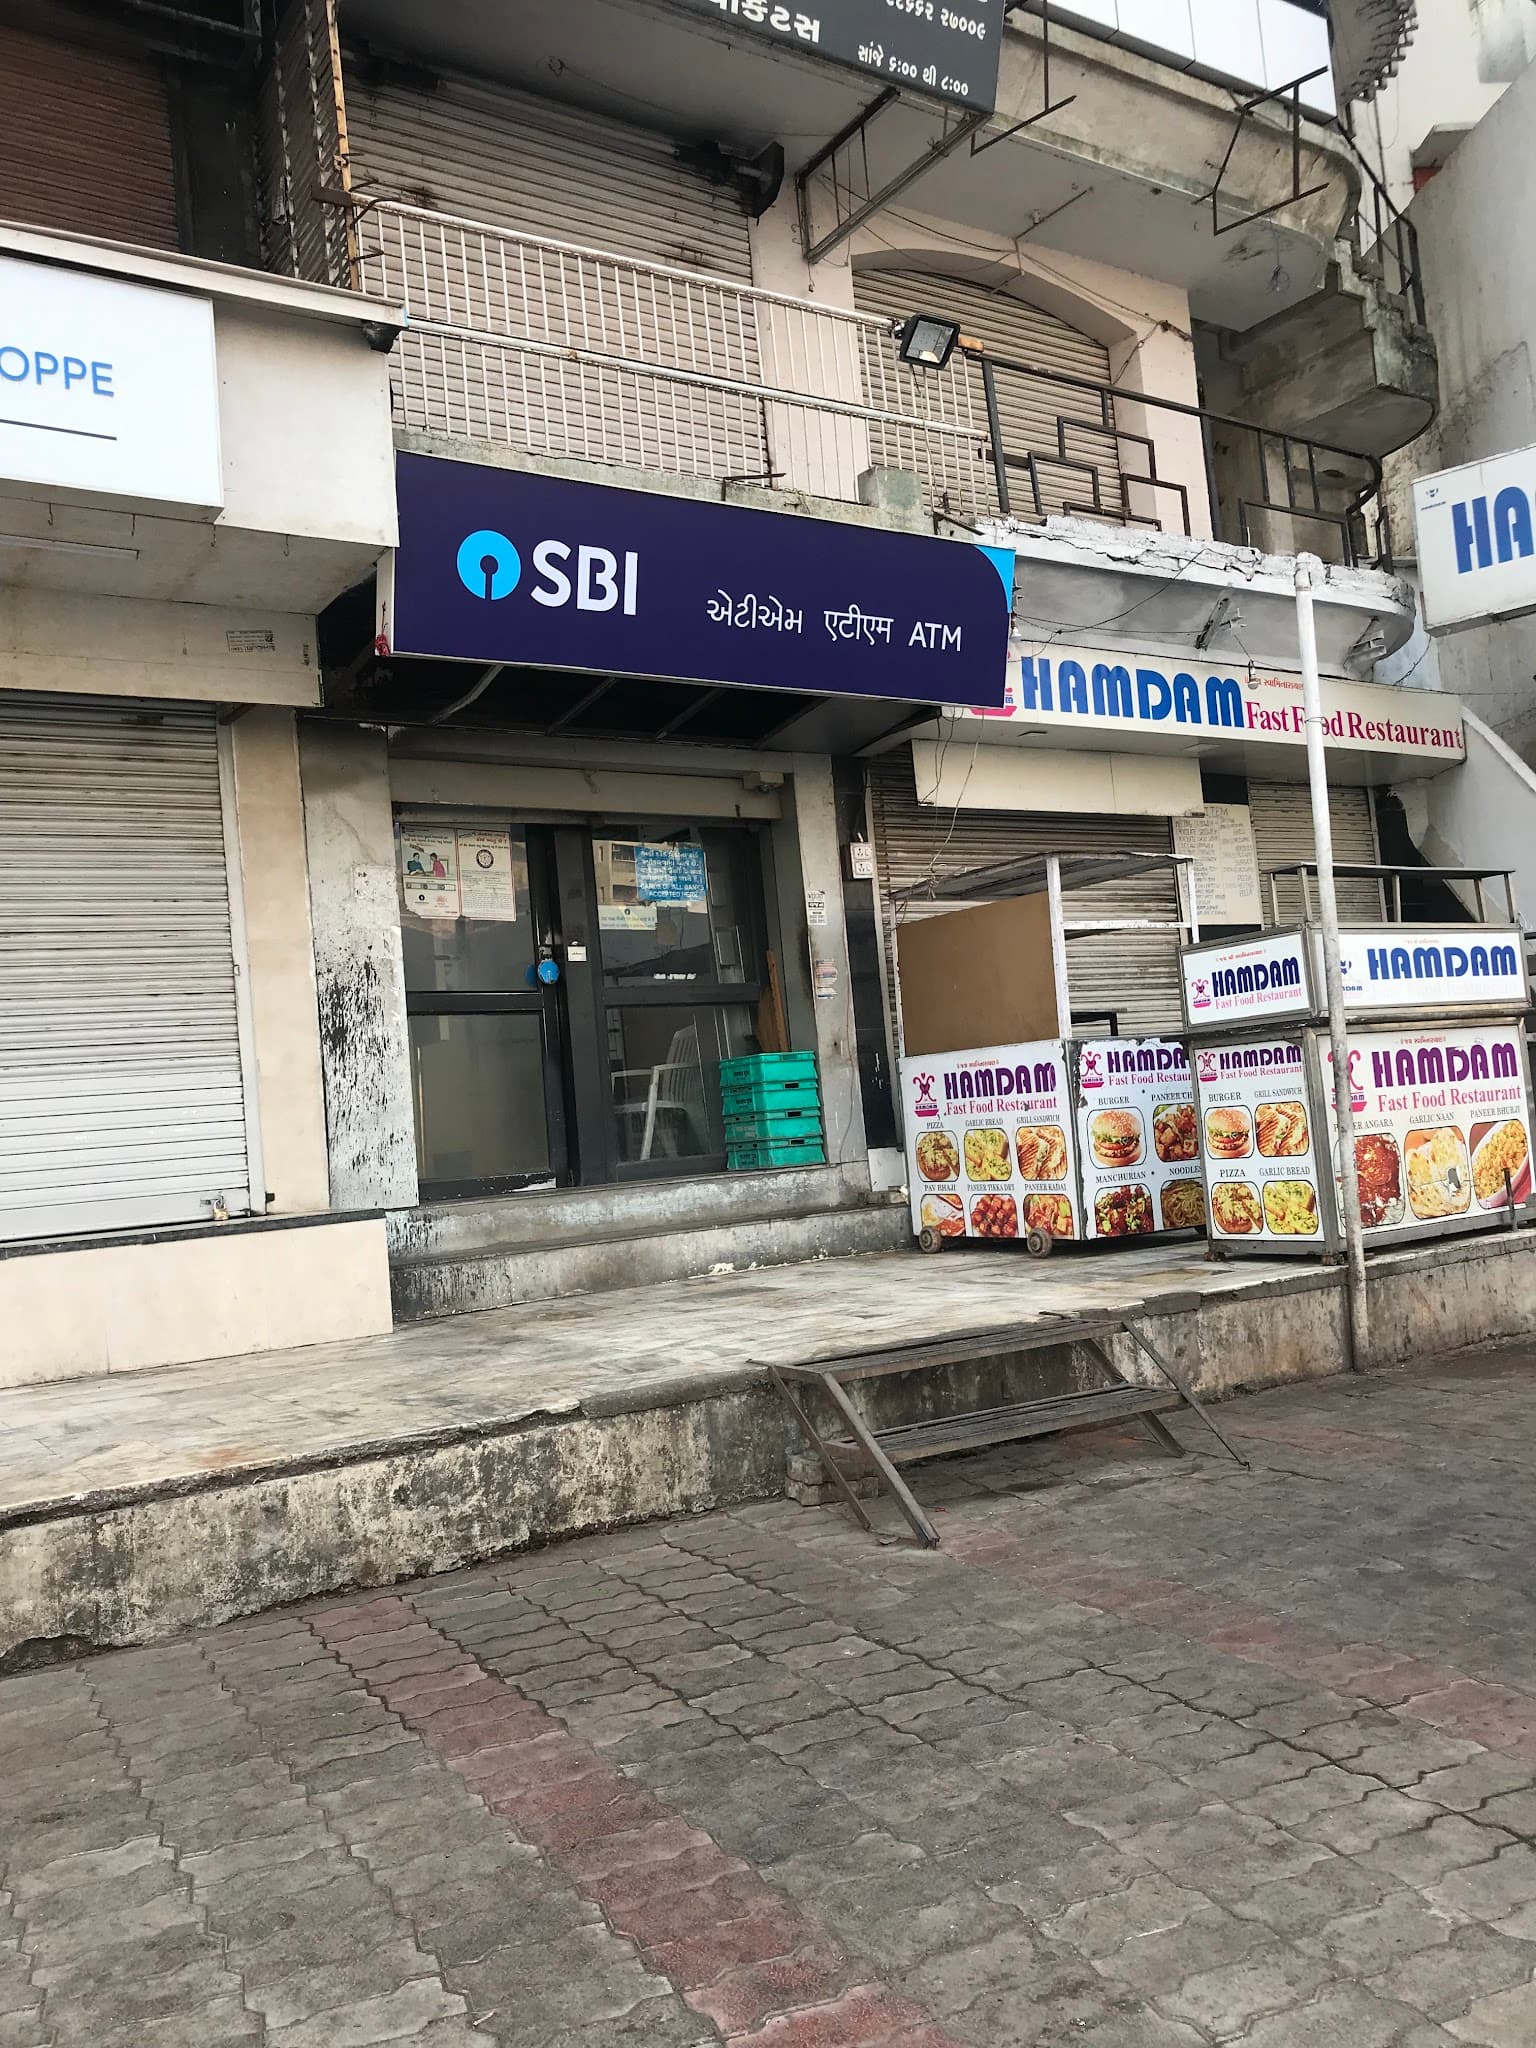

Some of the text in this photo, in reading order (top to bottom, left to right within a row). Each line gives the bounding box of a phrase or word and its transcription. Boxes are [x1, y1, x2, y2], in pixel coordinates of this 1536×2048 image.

[922, 65, 937, 86] થી
[0, 346, 114, 397] OPPE
[1452, 486, 1536, 574] HA
[530, 540, 962, 652] SBI એટીએમ एटीएम ATM
[1020, 655, 1245, 728] HAMDAM
[1245, 701, 1464, 749] Fast Fod Restaurant
[1367, 945, 1518, 980] HAMDAM
[1211, 956, 1301, 998] HAMDAM
[1215, 999, 1233, 1010] Fast
[1235, 993, 1255, 1007] Food
[1256, 987, 1302, 1004] Restaurant
[1220, 1045, 1302, 1070] HAMDAM
[1371, 1042, 1519, 1088] HAMDAM
[943, 1062, 1057, 1100] HAMDAM
[1109, 1074, 1128, 1086] Fast
[1131, 1072, 1154, 1085] Food
[1221, 1065, 1303, 1080] Fast Food Restaurant
[946, 1095, 1057, 1116] Fast Food Restaurant
[1098, 1096, 1130, 1106] BURGER
[1208, 1091, 1243, 1103] BURGER
[1378, 1084, 1521, 1112] Fast Food Restaurant
[1409, 1111, 1455, 1125] GARLIC NAAN
[1470, 1107, 1496, 1118] PANEER
[926, 1121, 944, 1129] PIZZA
[1365, 1119, 1394, 1129] ANGARA
[1096, 1171, 1147, 1184] MANCHURIAN
[1220, 1168, 1246, 1178] PIZZA
[1259, 1166, 1310, 1177] GARLIC BREAD
